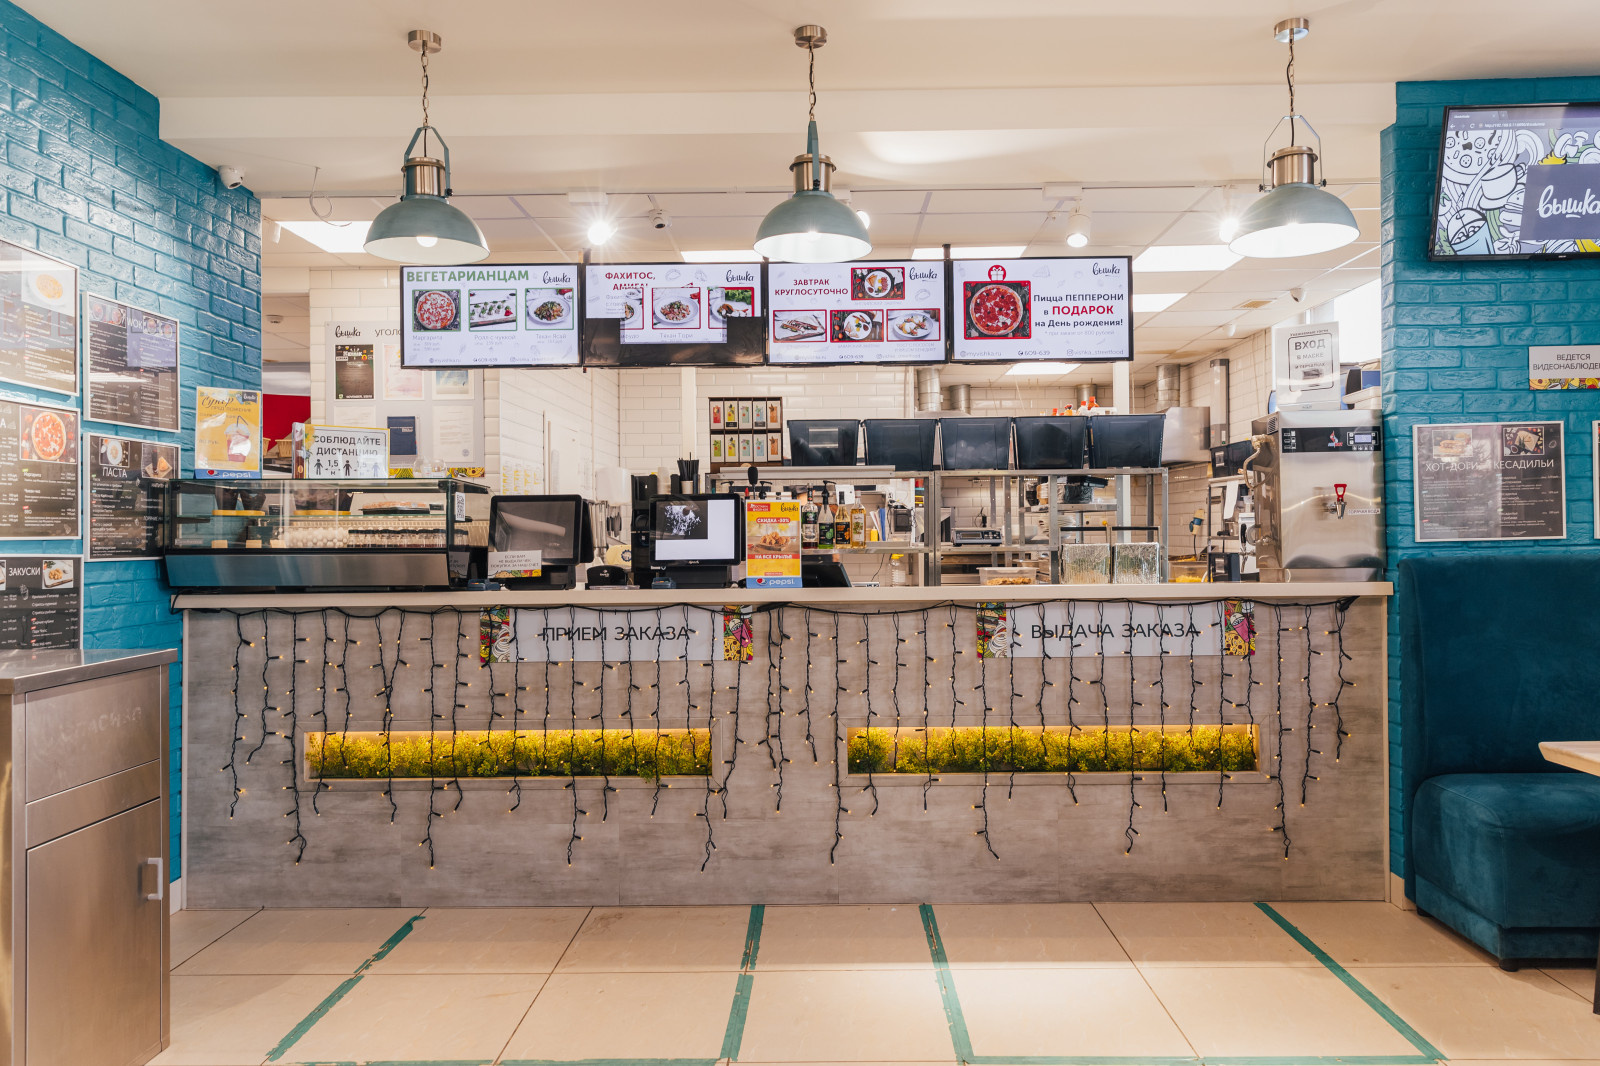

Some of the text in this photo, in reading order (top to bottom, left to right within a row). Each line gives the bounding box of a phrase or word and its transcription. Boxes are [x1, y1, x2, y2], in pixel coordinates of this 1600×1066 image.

[909, 267, 938, 281] вышка
[1092, 262, 1120, 276] вышка
[406, 270, 530, 283] ВЕГЕТАРИАНЦАМ
[542, 271, 571, 284] вышка
[605, 272, 656, 280] ФАХИТОС,
[725, 269, 754, 283] вышка
[1052, 306, 1114, 316] ПОДАРОК
[1048, 320, 1070, 328] День
[1073, 319, 1123, 328] рождения!
[335, 326, 360, 338] вышка
[1294, 338, 1326, 350] ВХОД
[314, 436, 380, 446] СОБЛЮДАЙТЕ
[316, 448, 378, 456] ДИСТАНЦИЮ
[328, 460, 338, 468] 1,5
[1493, 460, 1554, 470] КЕСАДИЛЬИ
[102, 467, 128, 478] ПАСТА
[8, 566, 40, 576] ЗАКУСКИ
[541, 626, 690, 641] ПРИЕМ ЗАКАЗА
[1031, 623, 1200, 641] ВЫДАЧА ЗАКАЗА
